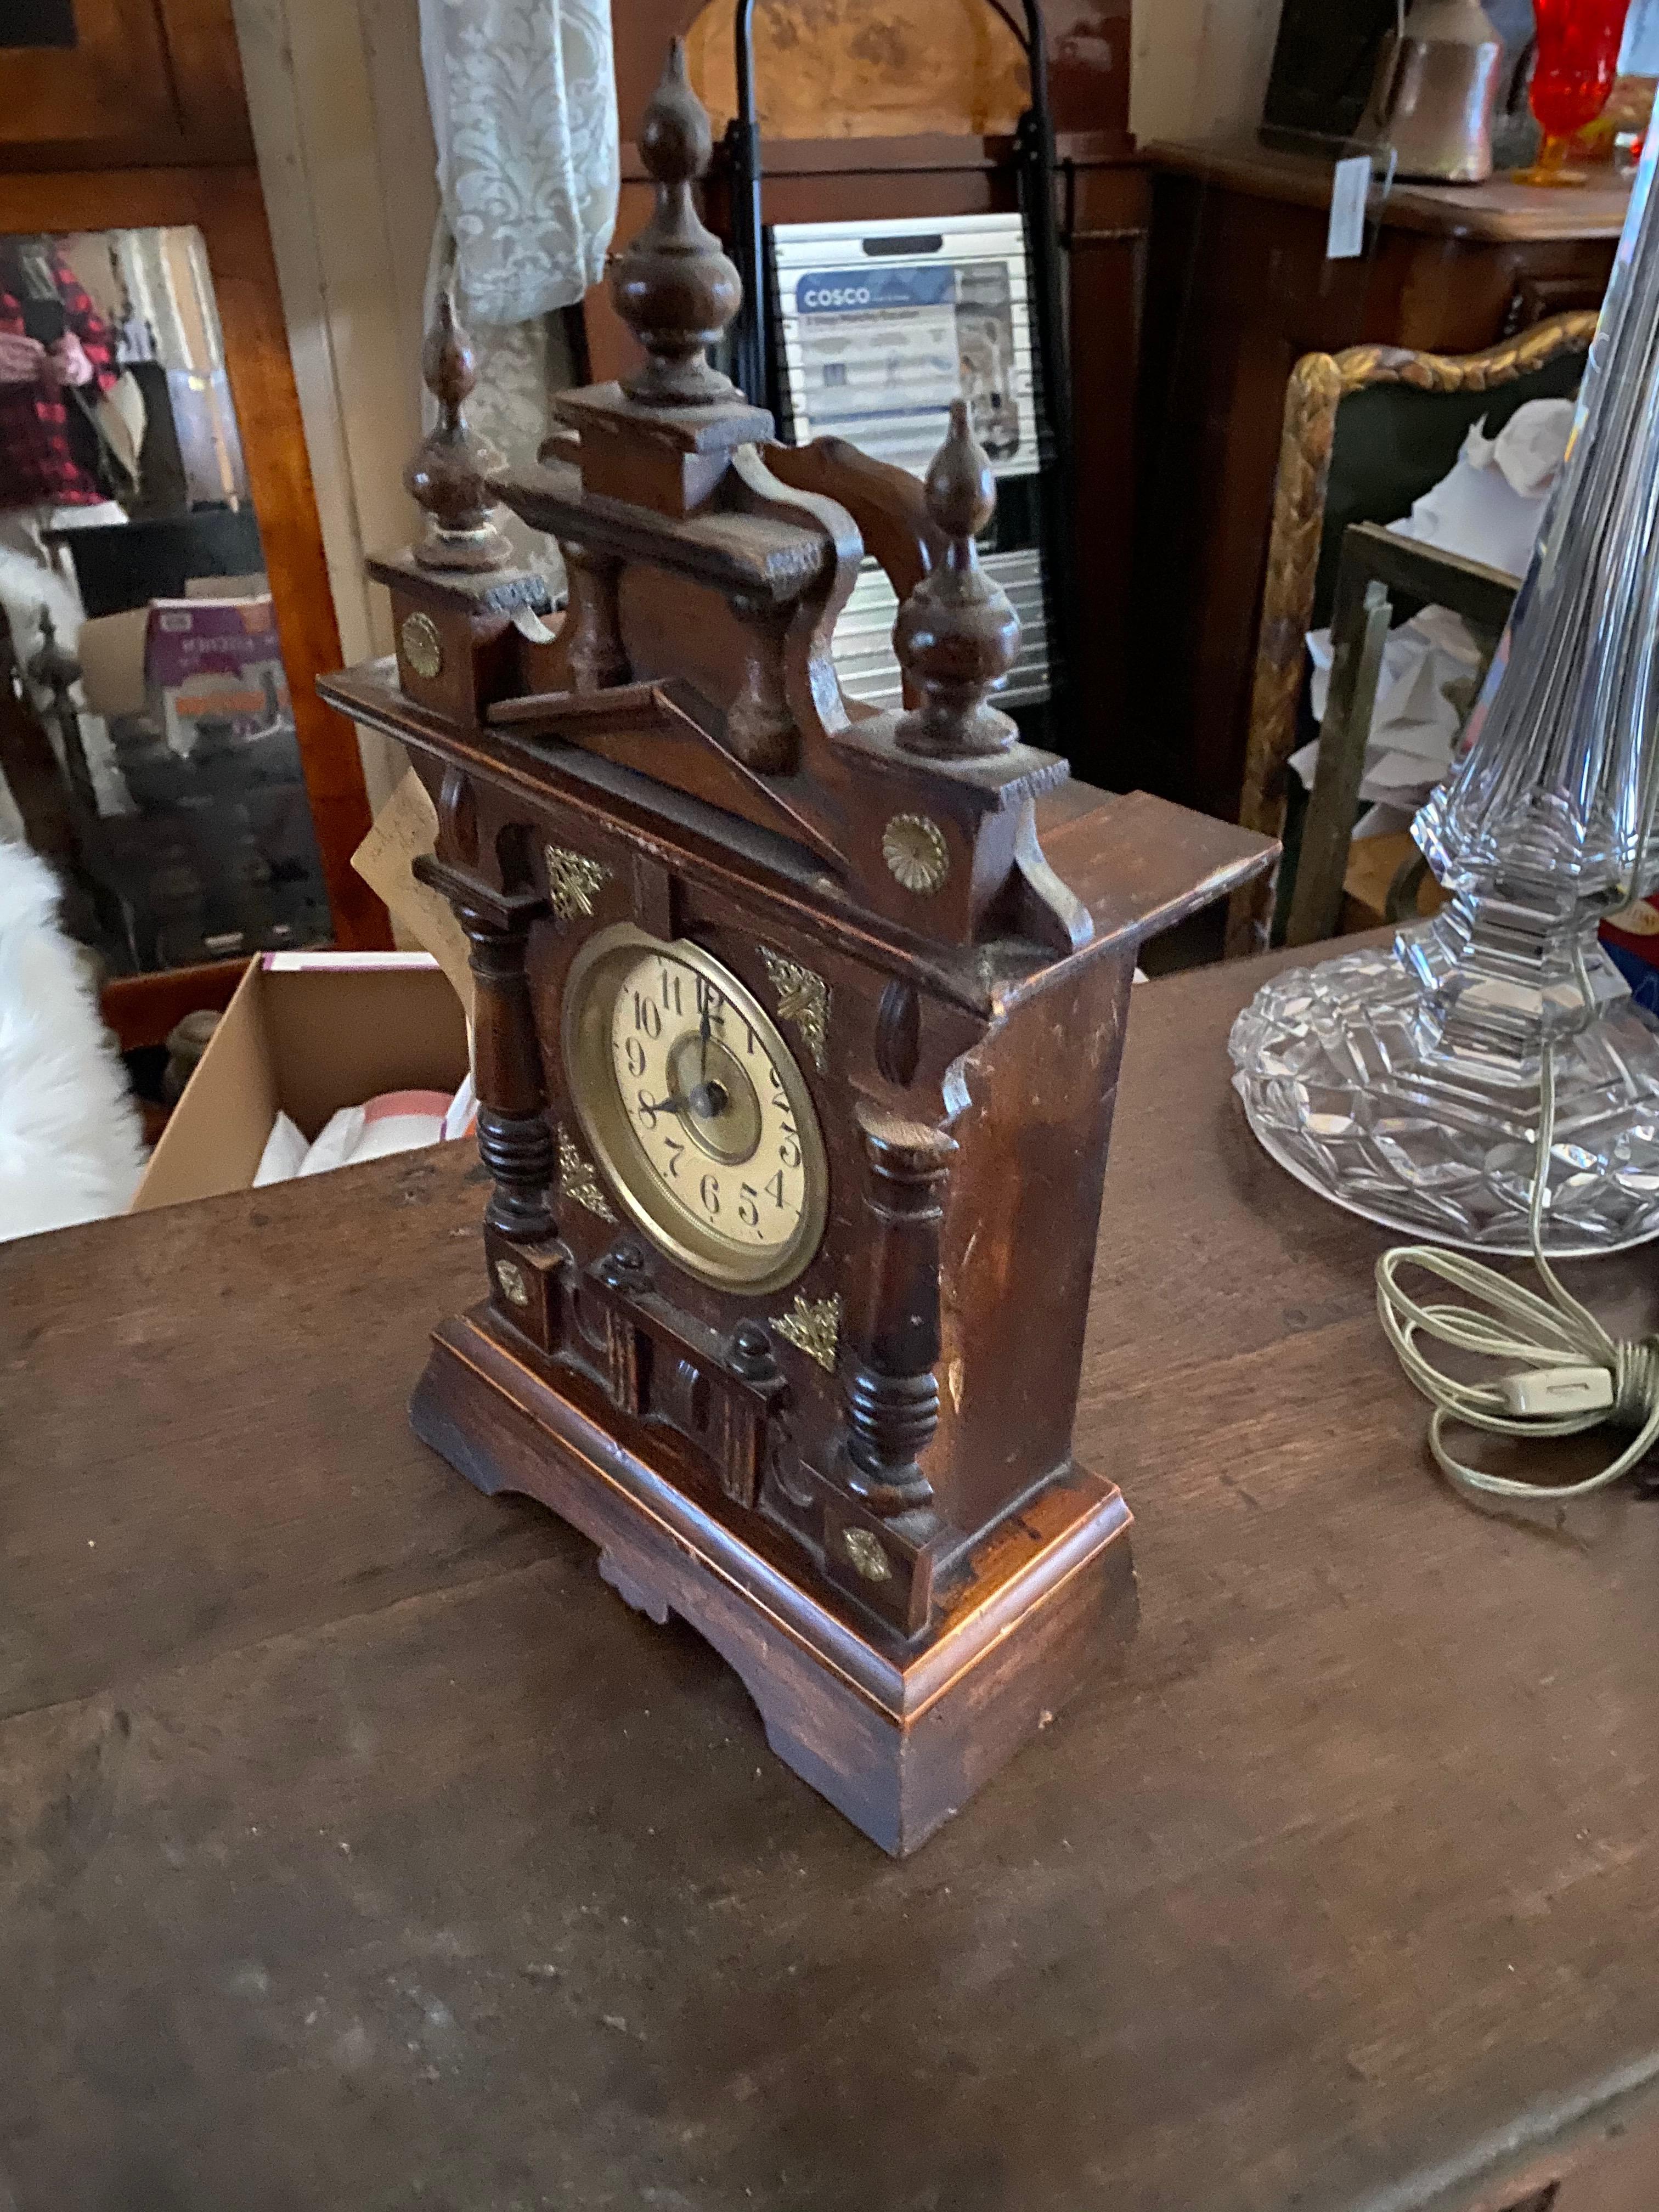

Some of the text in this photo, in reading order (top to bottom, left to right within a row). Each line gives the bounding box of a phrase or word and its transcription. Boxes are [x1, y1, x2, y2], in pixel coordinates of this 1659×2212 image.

[804, 287, 870, 307] COSCO
[662, 968, 682, 1016] 11
[634, 990, 661, 1040] 10
[625, 1036, 646, 1077] 9
[638, 1088, 657, 1130] 8
[664, 1136, 685, 1178] 7
[778, 1121, 801, 1168] 3
[700, 1174, 719, 1214] 6
[739, 1182, 758, 1227] 5
[764, 1169, 792, 1209] 4
